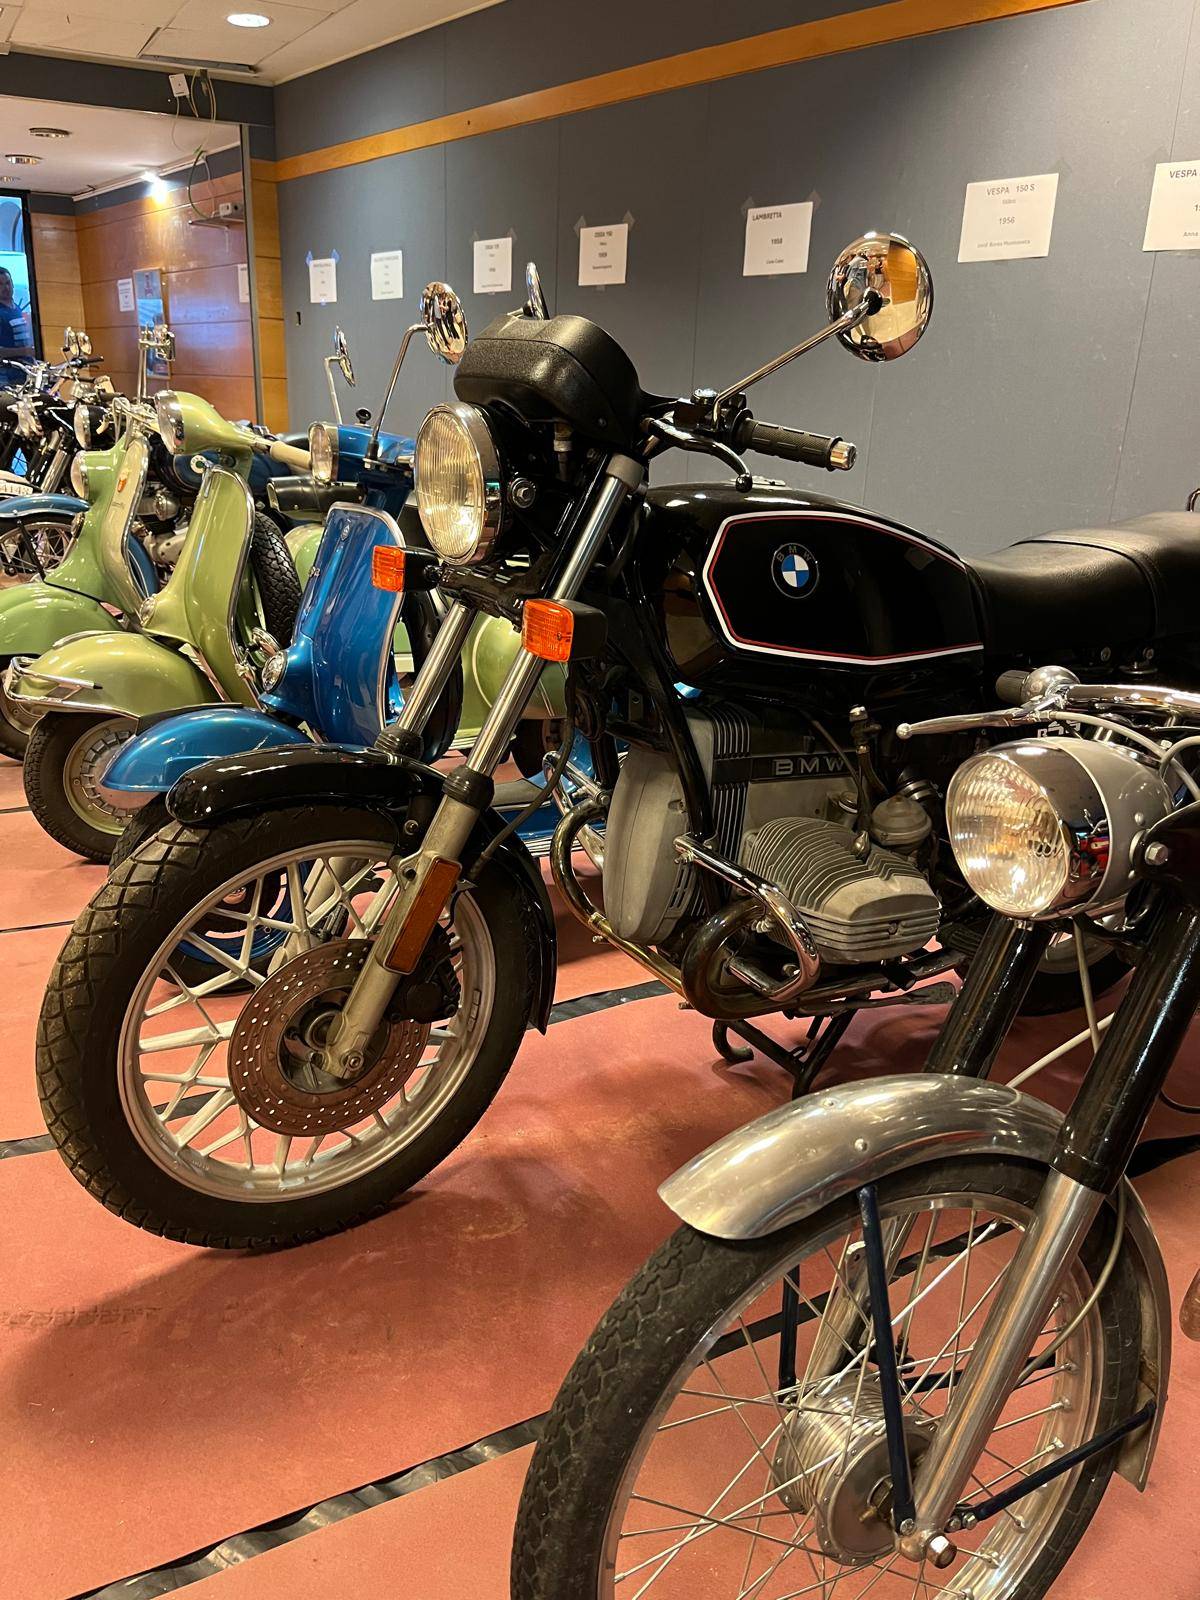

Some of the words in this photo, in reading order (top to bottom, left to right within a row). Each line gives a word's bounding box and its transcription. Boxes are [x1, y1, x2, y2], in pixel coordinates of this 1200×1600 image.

[1169, 169, 1197, 179] VESPA
[986, 186, 1010, 196] VESPA
[752, 211, 782, 221] LAMBRETTA
[999, 216, 1016, 225] 1956
[774, 756, 844, 776] BMW
